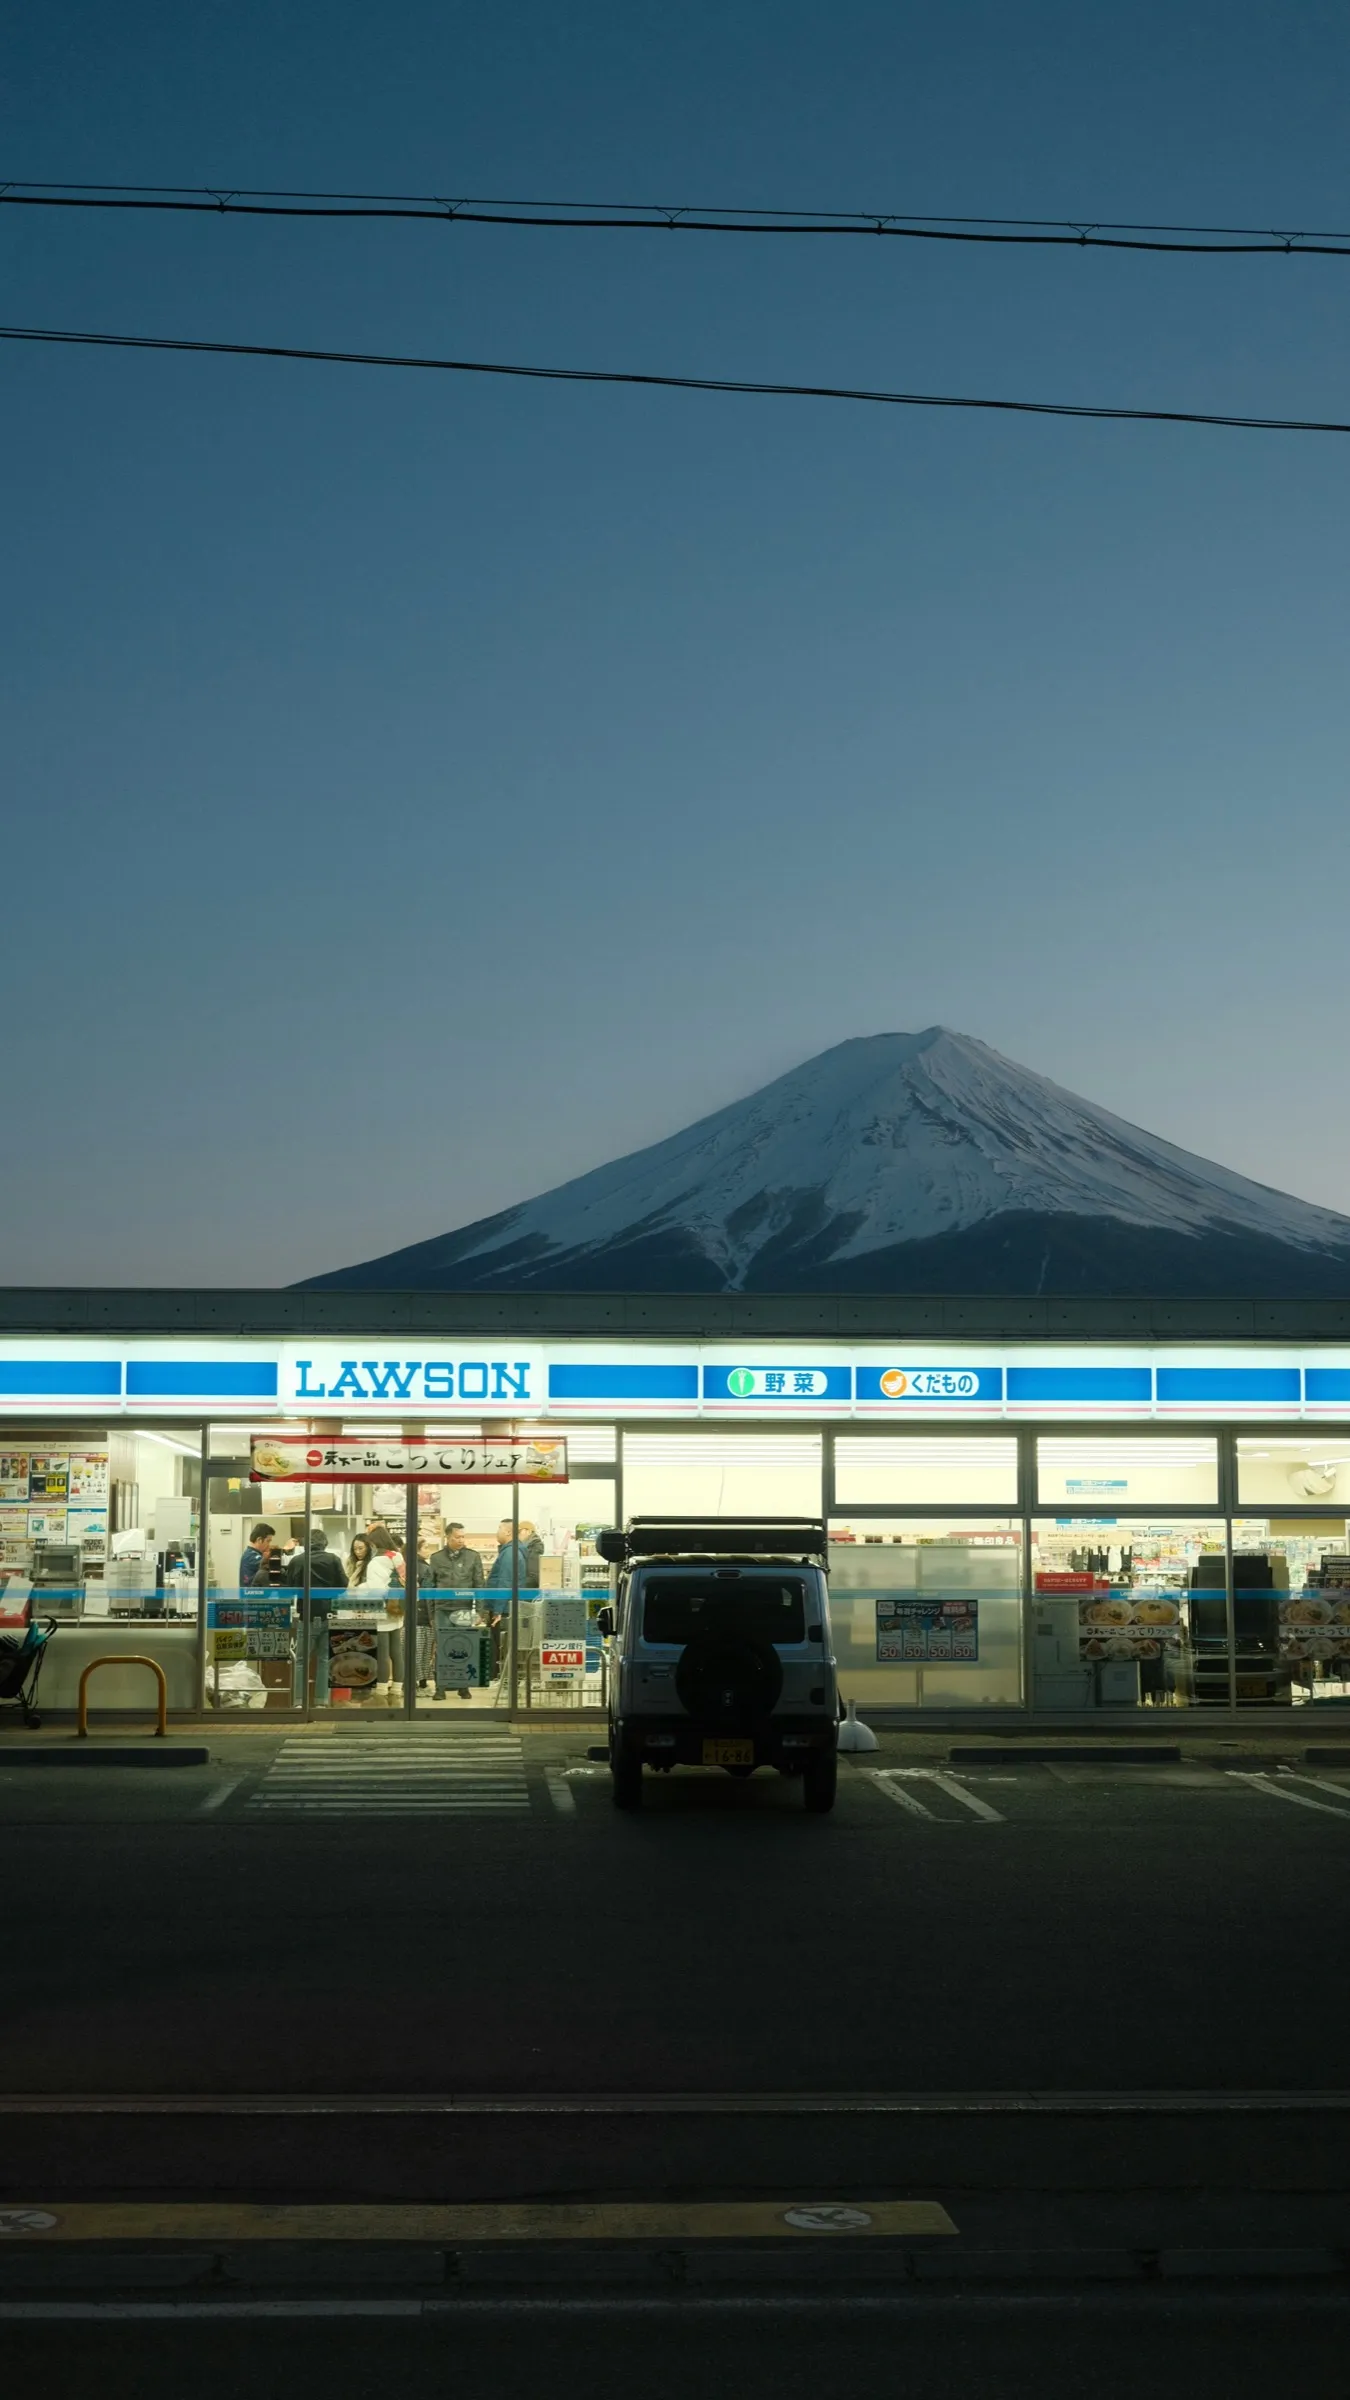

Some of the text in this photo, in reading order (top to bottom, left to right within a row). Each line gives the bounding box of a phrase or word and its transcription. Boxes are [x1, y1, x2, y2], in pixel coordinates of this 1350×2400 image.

[295, 1361, 531, 1398] LAWSON
[765, 1372, 815, 1393] 野菜
[911, 1374, 974, 1394] くだもの
[548, 1653, 577, 1664] ATM
